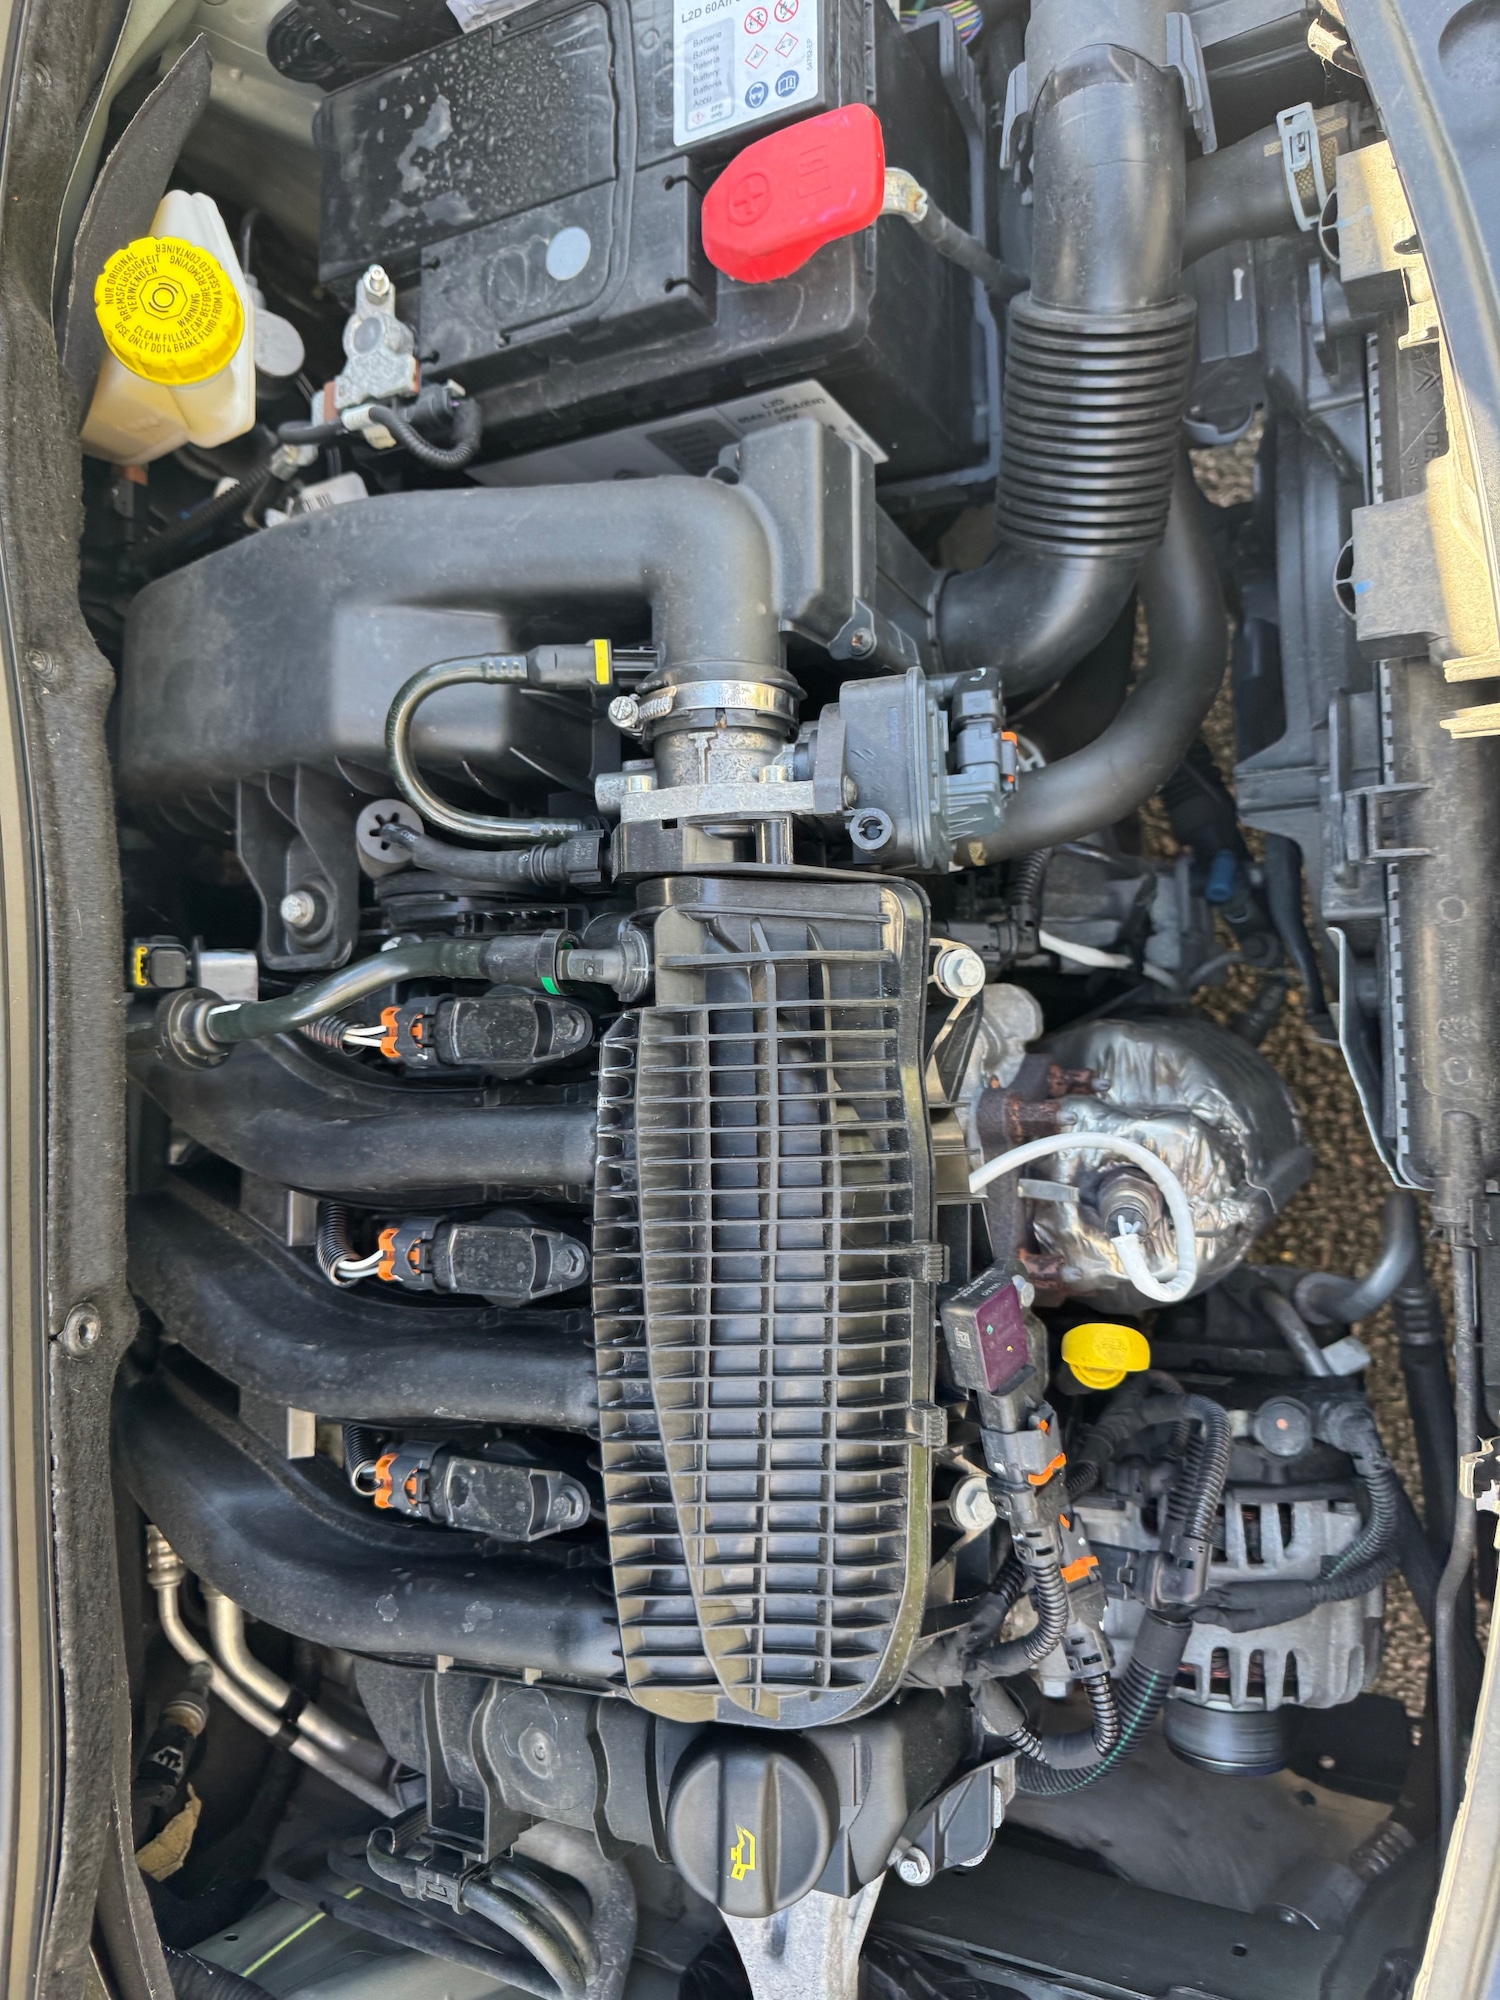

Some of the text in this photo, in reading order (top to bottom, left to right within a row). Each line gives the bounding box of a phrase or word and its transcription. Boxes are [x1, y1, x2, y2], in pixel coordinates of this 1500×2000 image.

[681, 8, 702, 24] L2D
[692, 31, 722, 48] Batterie
[692, 68, 720, 84] Battery
[692, 80, 722, 96] Batteria
[693, 97, 712, 108] Accu
[156, 244, 201, 263] CONTAINER
[105, 252, 138, 305] NUR ORIGINAL
[200, 261, 221, 289] SEALED
[116, 254, 160, 322] BREMSFLÜSSIGKEIT
[126, 265, 158, 312] VERWENDEN
[134, 255, 212, 342] CLEAN FILLER CAP BEFORE REMOVING
[178, 294, 200, 327] WARNING
[212, 297, 224, 320] FROM
[115, 322, 130, 338] USE
[199, 319, 218, 341] FLUID
[128, 334, 149, 350] ONLY
[150, 345, 172, 354] DOT4
[174, 337, 200, 352] BRAKE
[981, 1282, 1001, 1296] VALEO
